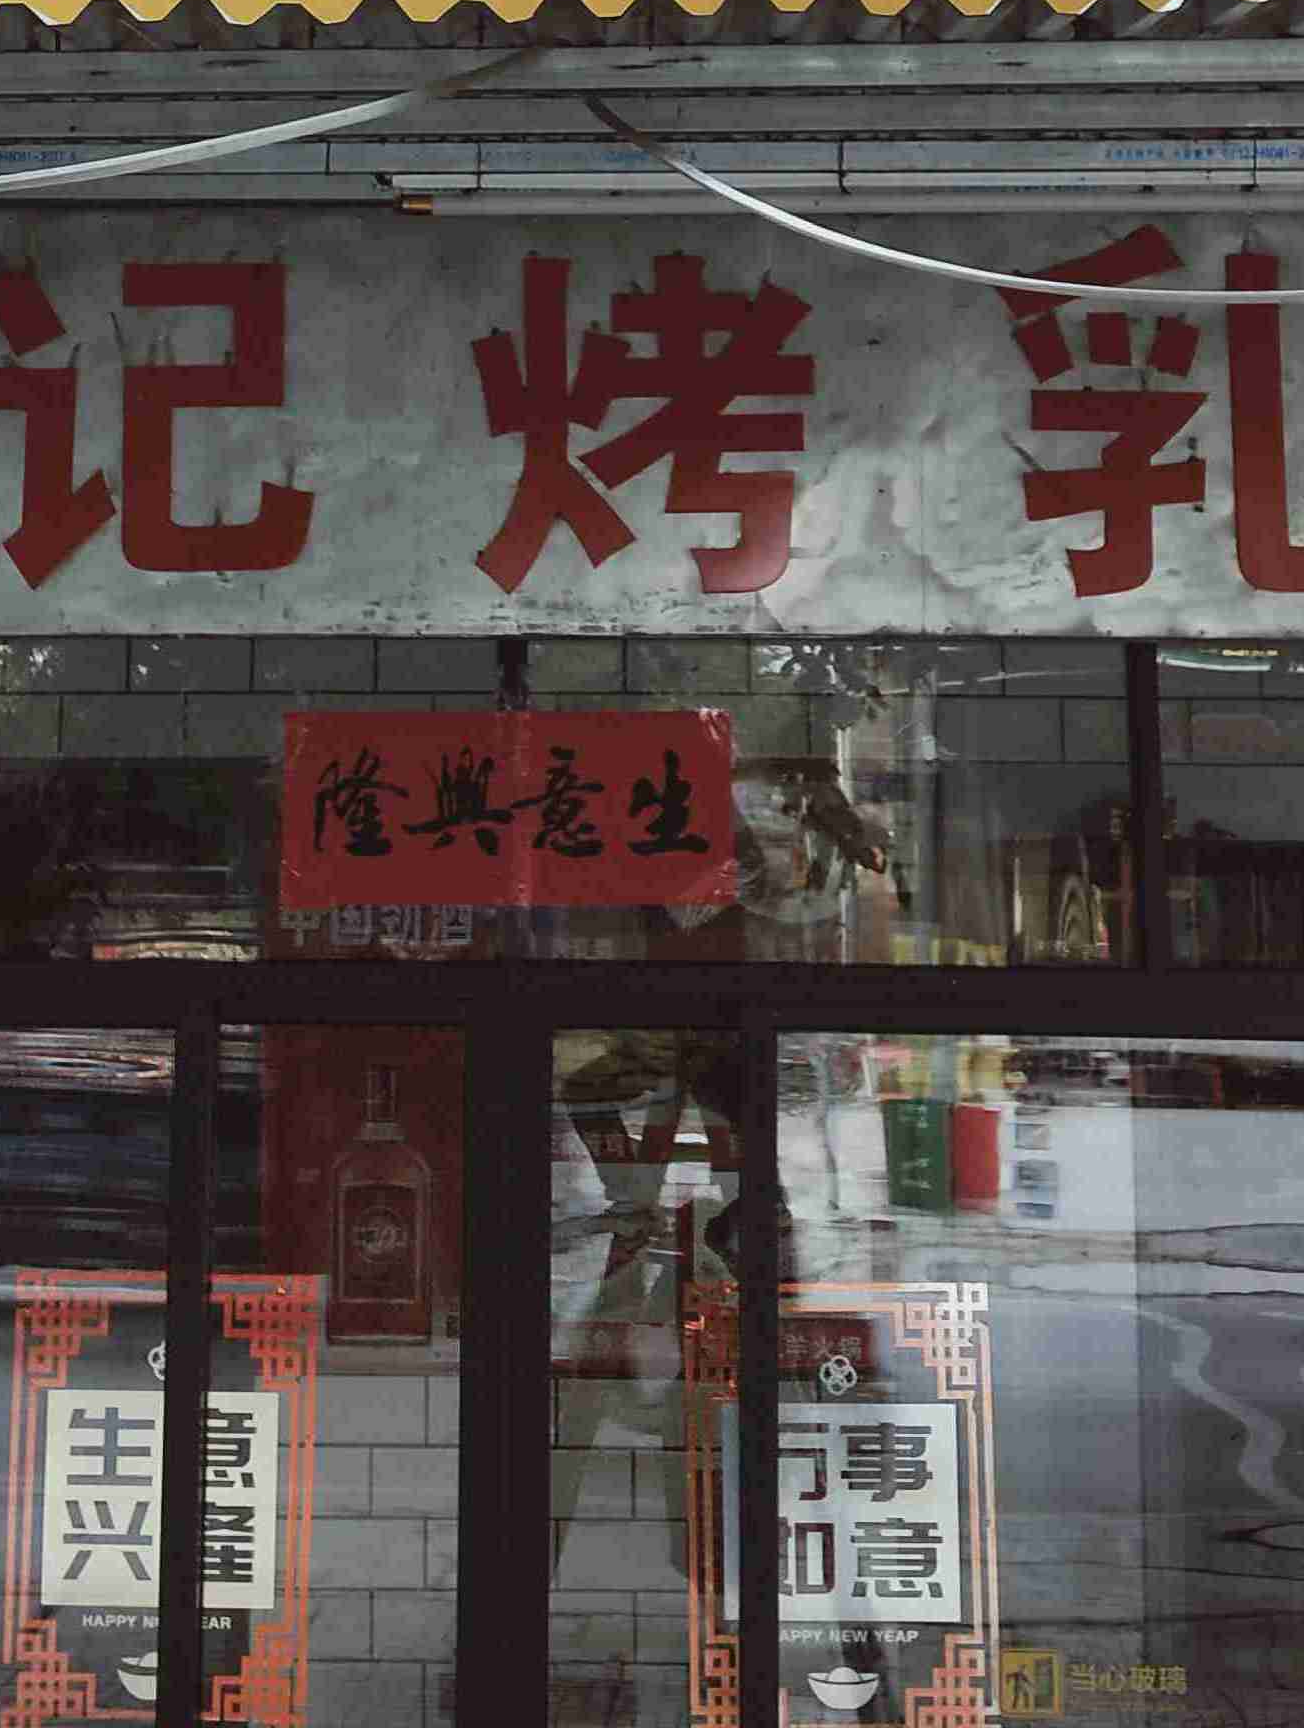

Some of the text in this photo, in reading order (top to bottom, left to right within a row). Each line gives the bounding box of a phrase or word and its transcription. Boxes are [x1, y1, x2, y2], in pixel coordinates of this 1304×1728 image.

[81, 1614, 138, 1629] HAPPY
[200, 1616, 232, 1630] EAR
[779, 1629, 823, 1643] APPY
[829, 1629, 868, 1643] NEW
